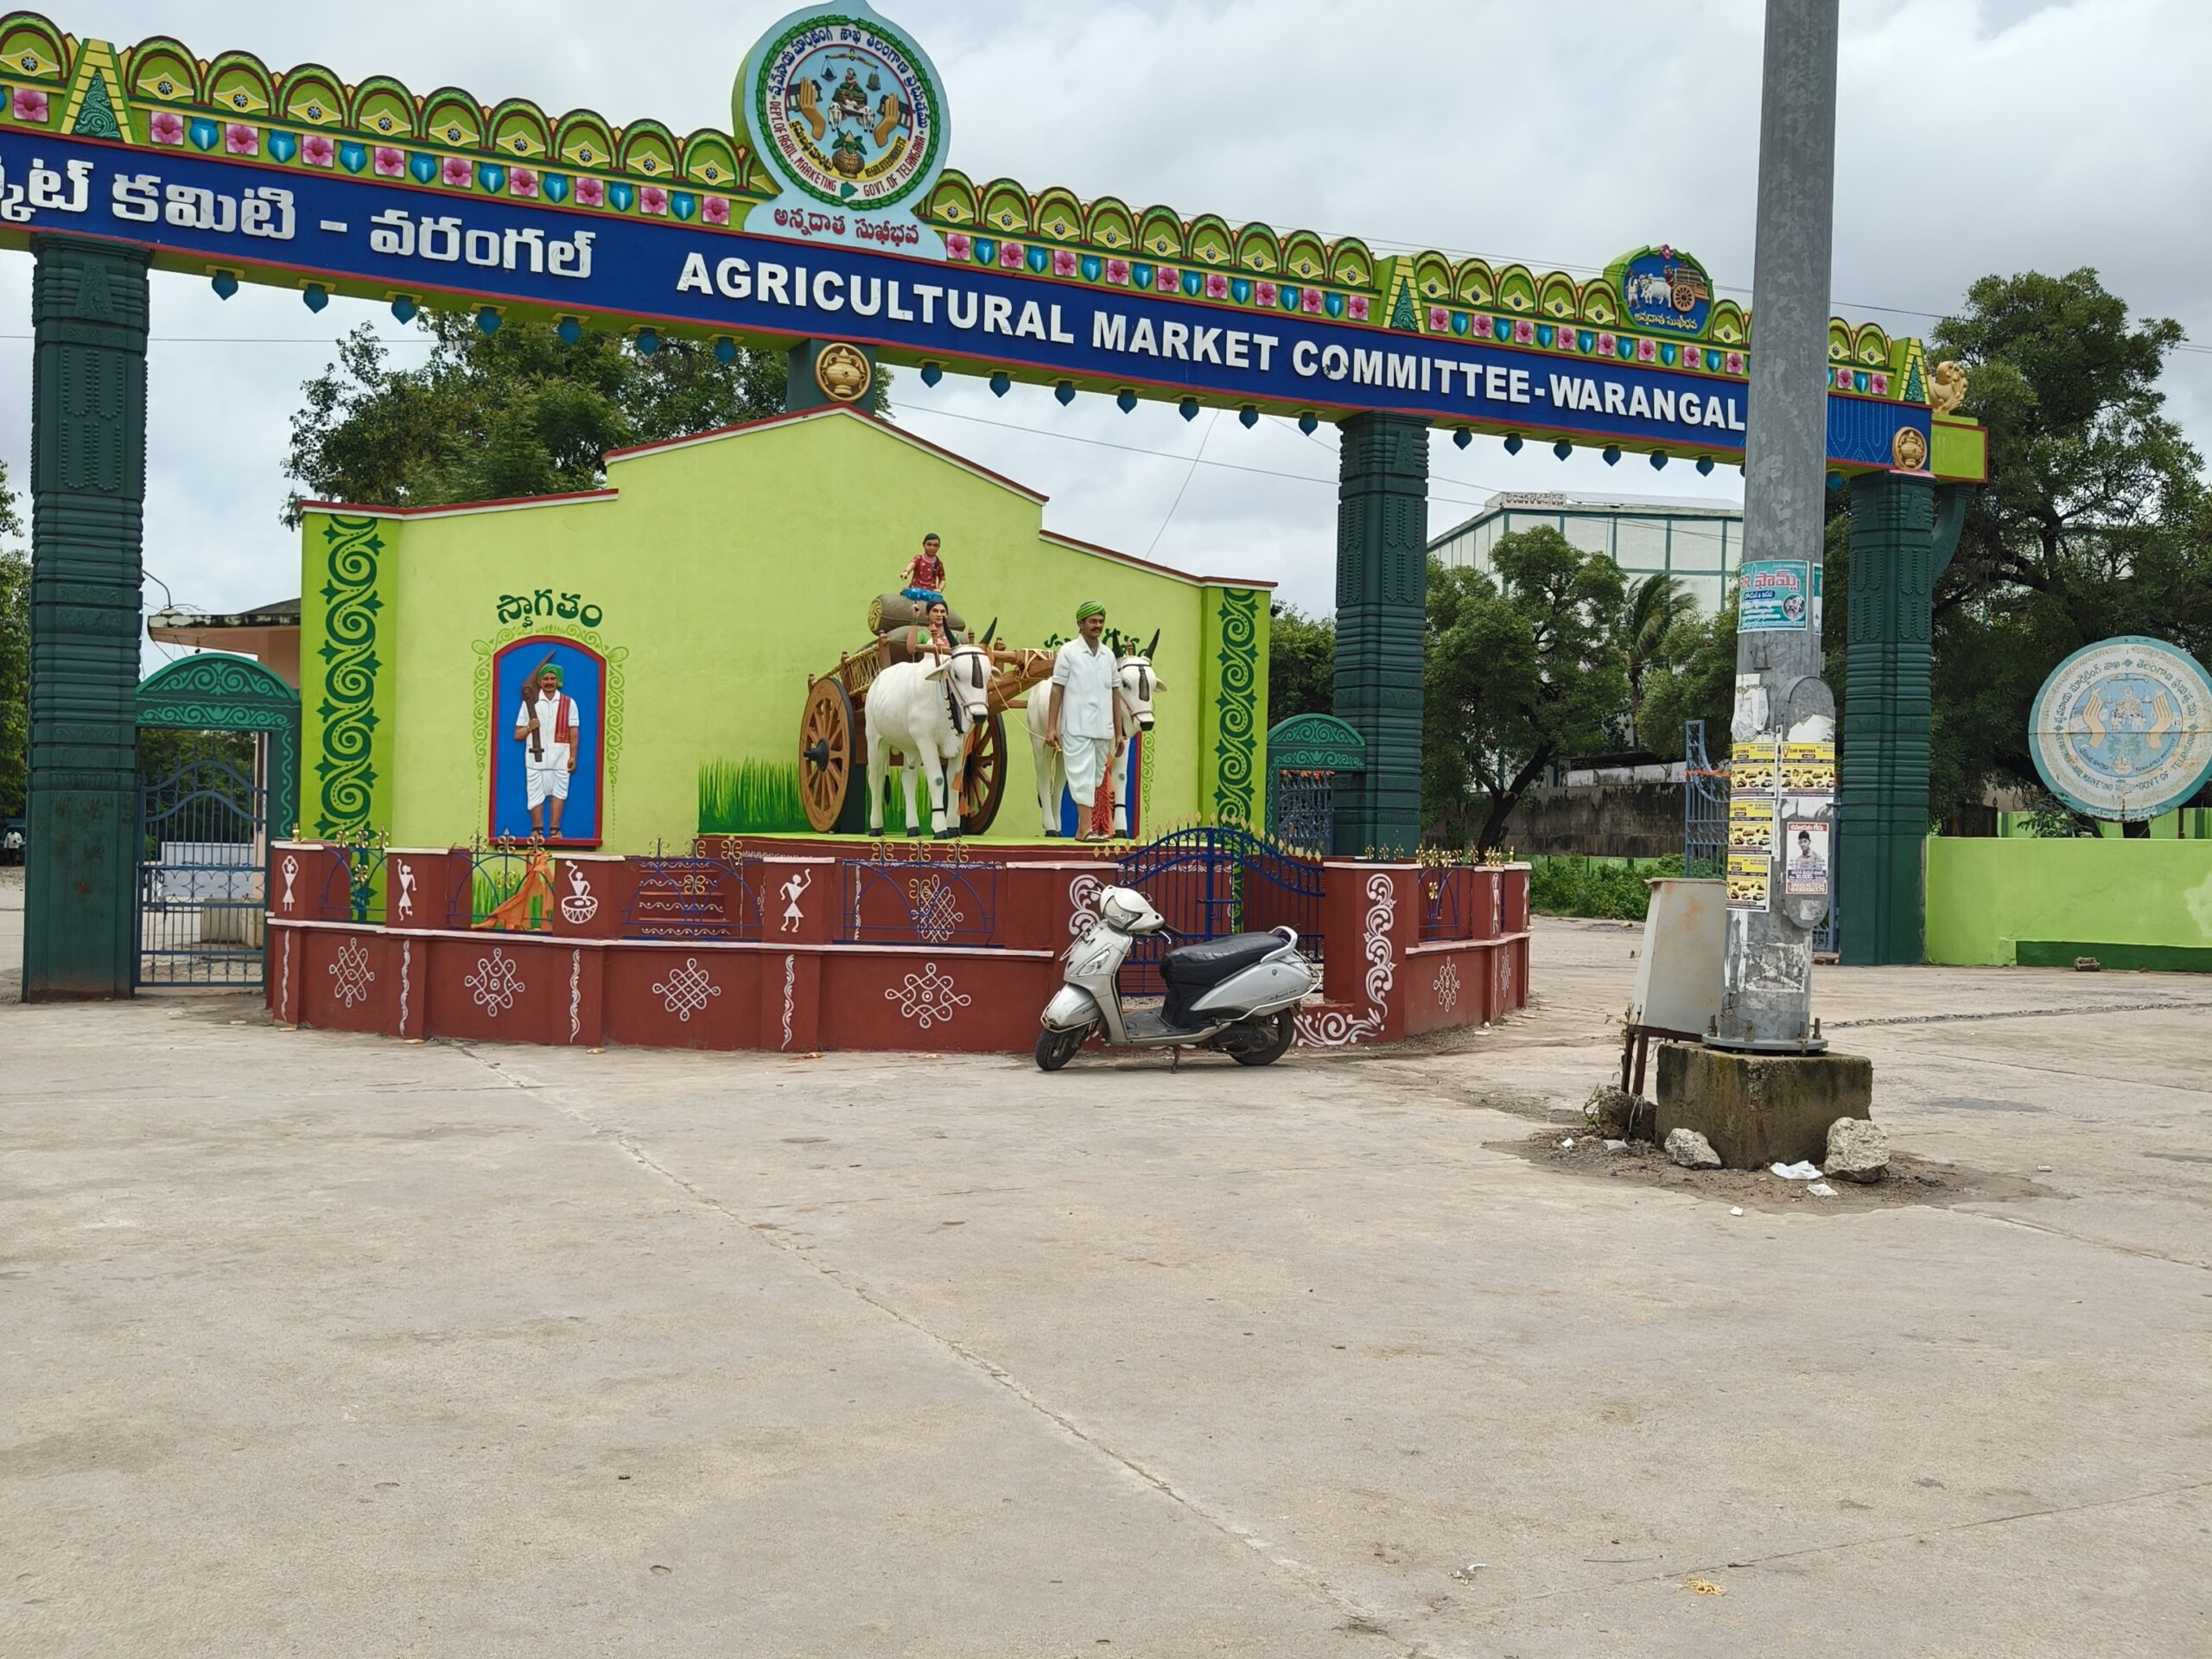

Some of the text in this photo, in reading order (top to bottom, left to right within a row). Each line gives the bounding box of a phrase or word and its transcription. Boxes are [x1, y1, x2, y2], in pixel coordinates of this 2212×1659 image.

[794, 156, 836, 192] MARKETING
[887, 174, 899, 189] OF
[899, 135, 926, 179] TELANGANA
[370, 209, 596, 279] వరంగల్
[773, 208, 920, 247] అన్నదాత సుఖీభవ
[676, 251, 1746, 432] AGRICULTURAL MARKET COMMITTEE-WARANGAL
[496, 588, 603, 628] స్వాగతం
[2160, 771, 2171, 783] OF
